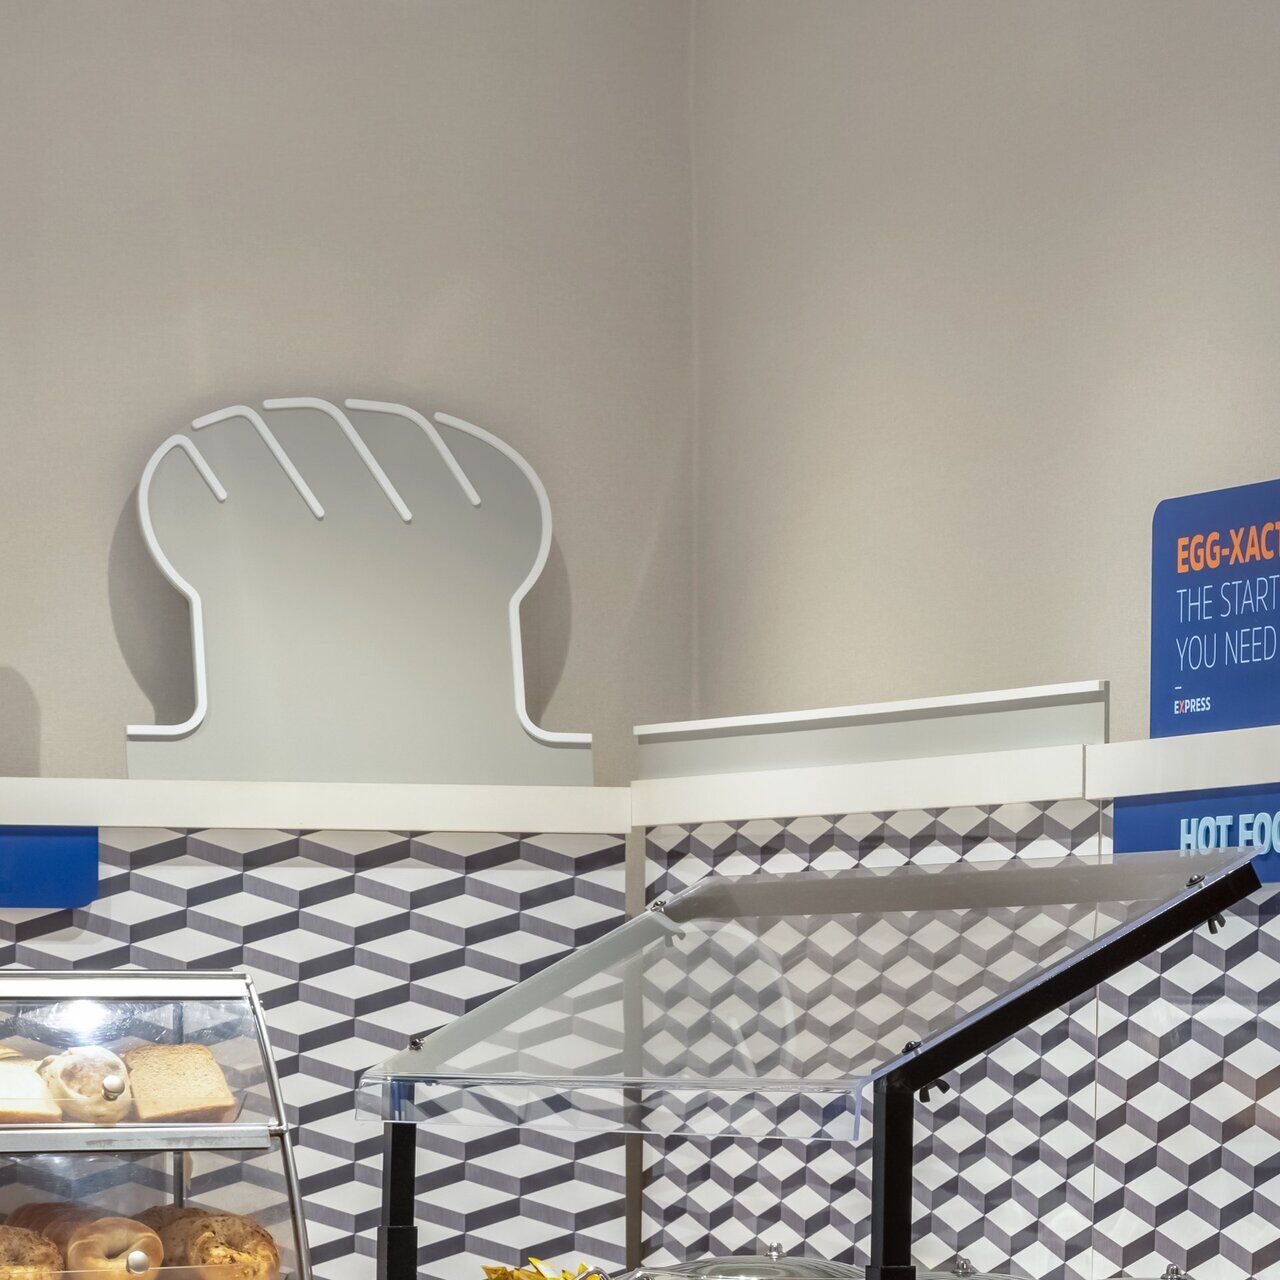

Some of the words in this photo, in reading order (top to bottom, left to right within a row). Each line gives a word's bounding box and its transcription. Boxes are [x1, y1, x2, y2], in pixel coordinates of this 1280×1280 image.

[1176, 585, 1213, 623] THE
[1220, 574, 1280, 618] START
[1175, 632, 1217, 671] YOU
[1224, 625, 1277, 666] NEED
[1174, 697, 1211, 714] EXPRESS
[1179, 814, 1234, 857] HOT
